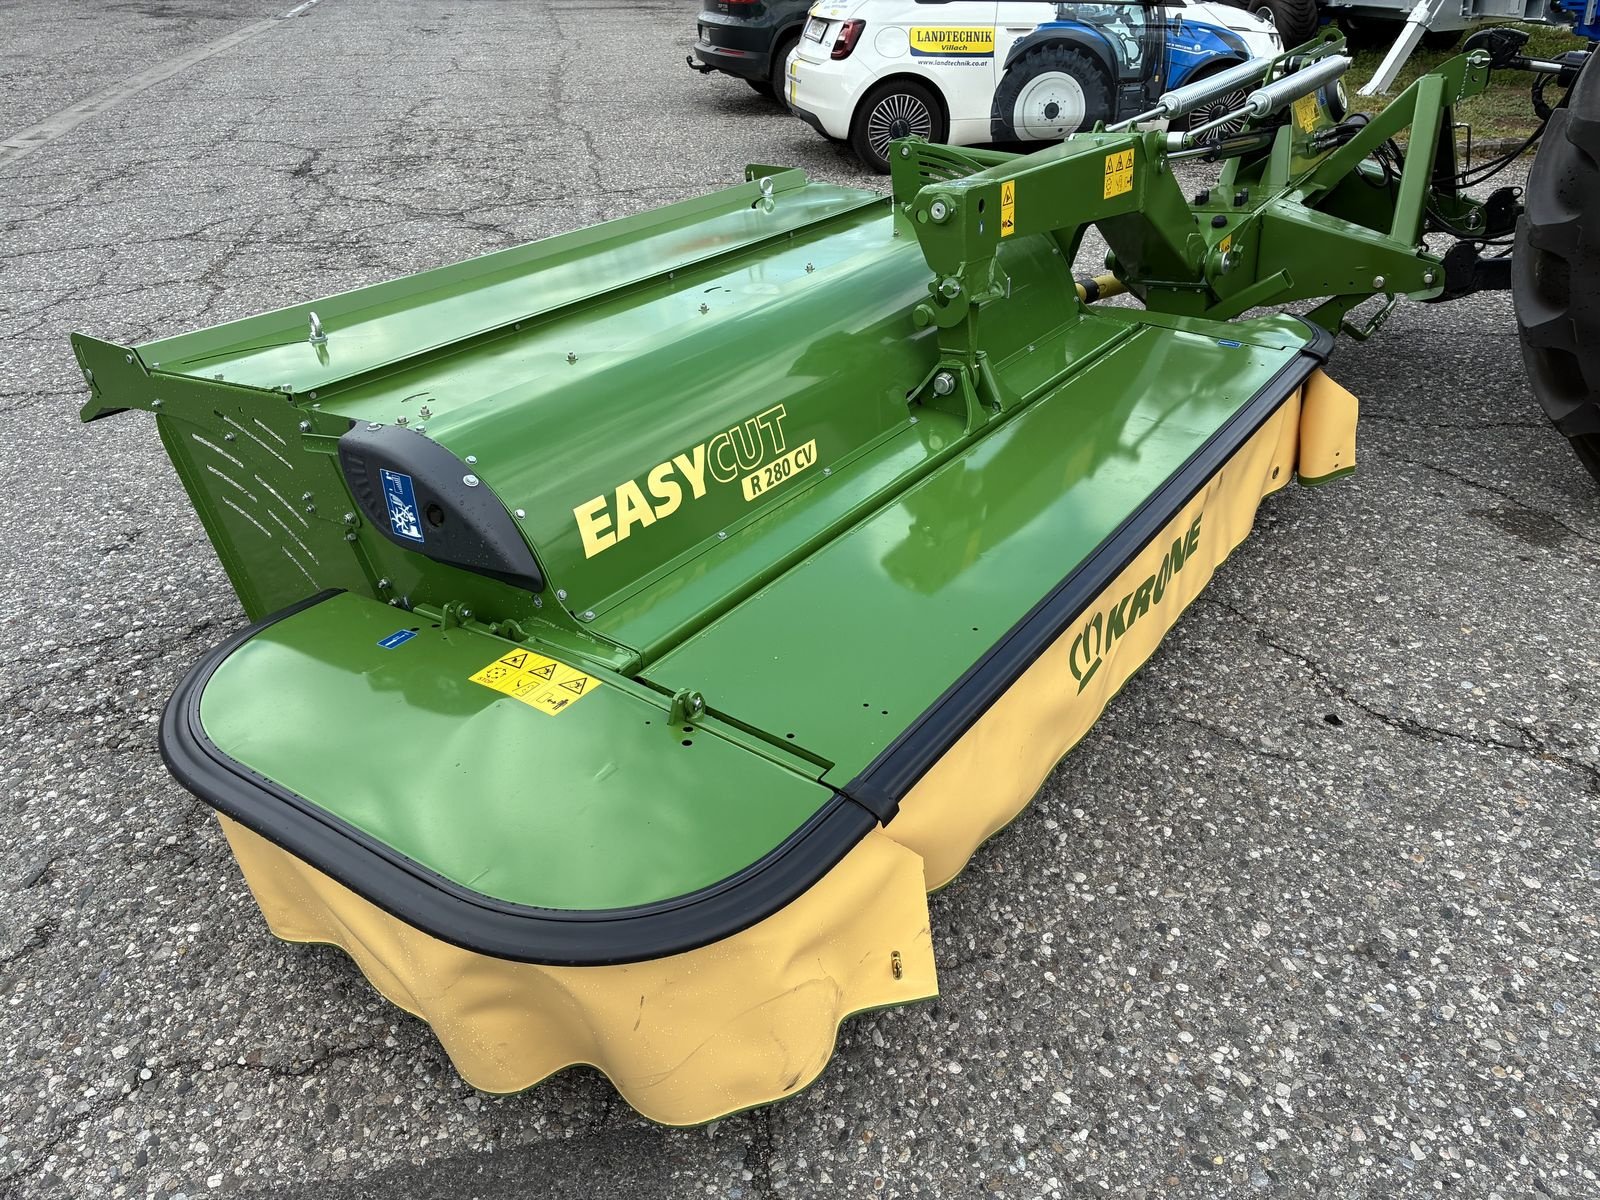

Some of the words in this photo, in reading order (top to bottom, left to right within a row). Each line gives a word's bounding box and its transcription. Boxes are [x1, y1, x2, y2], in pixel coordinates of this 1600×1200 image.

[916, 30, 993, 43] LANDTECHNIK
[917, 59, 988, 67] www.landtechnik.co.at
[573, 403, 787, 559] EASYCUT
[750, 474, 762, 496] R
[764, 457, 791, 488] 280
[794, 443, 812, 469] CV
[1105, 511, 1203, 655] KRONE
